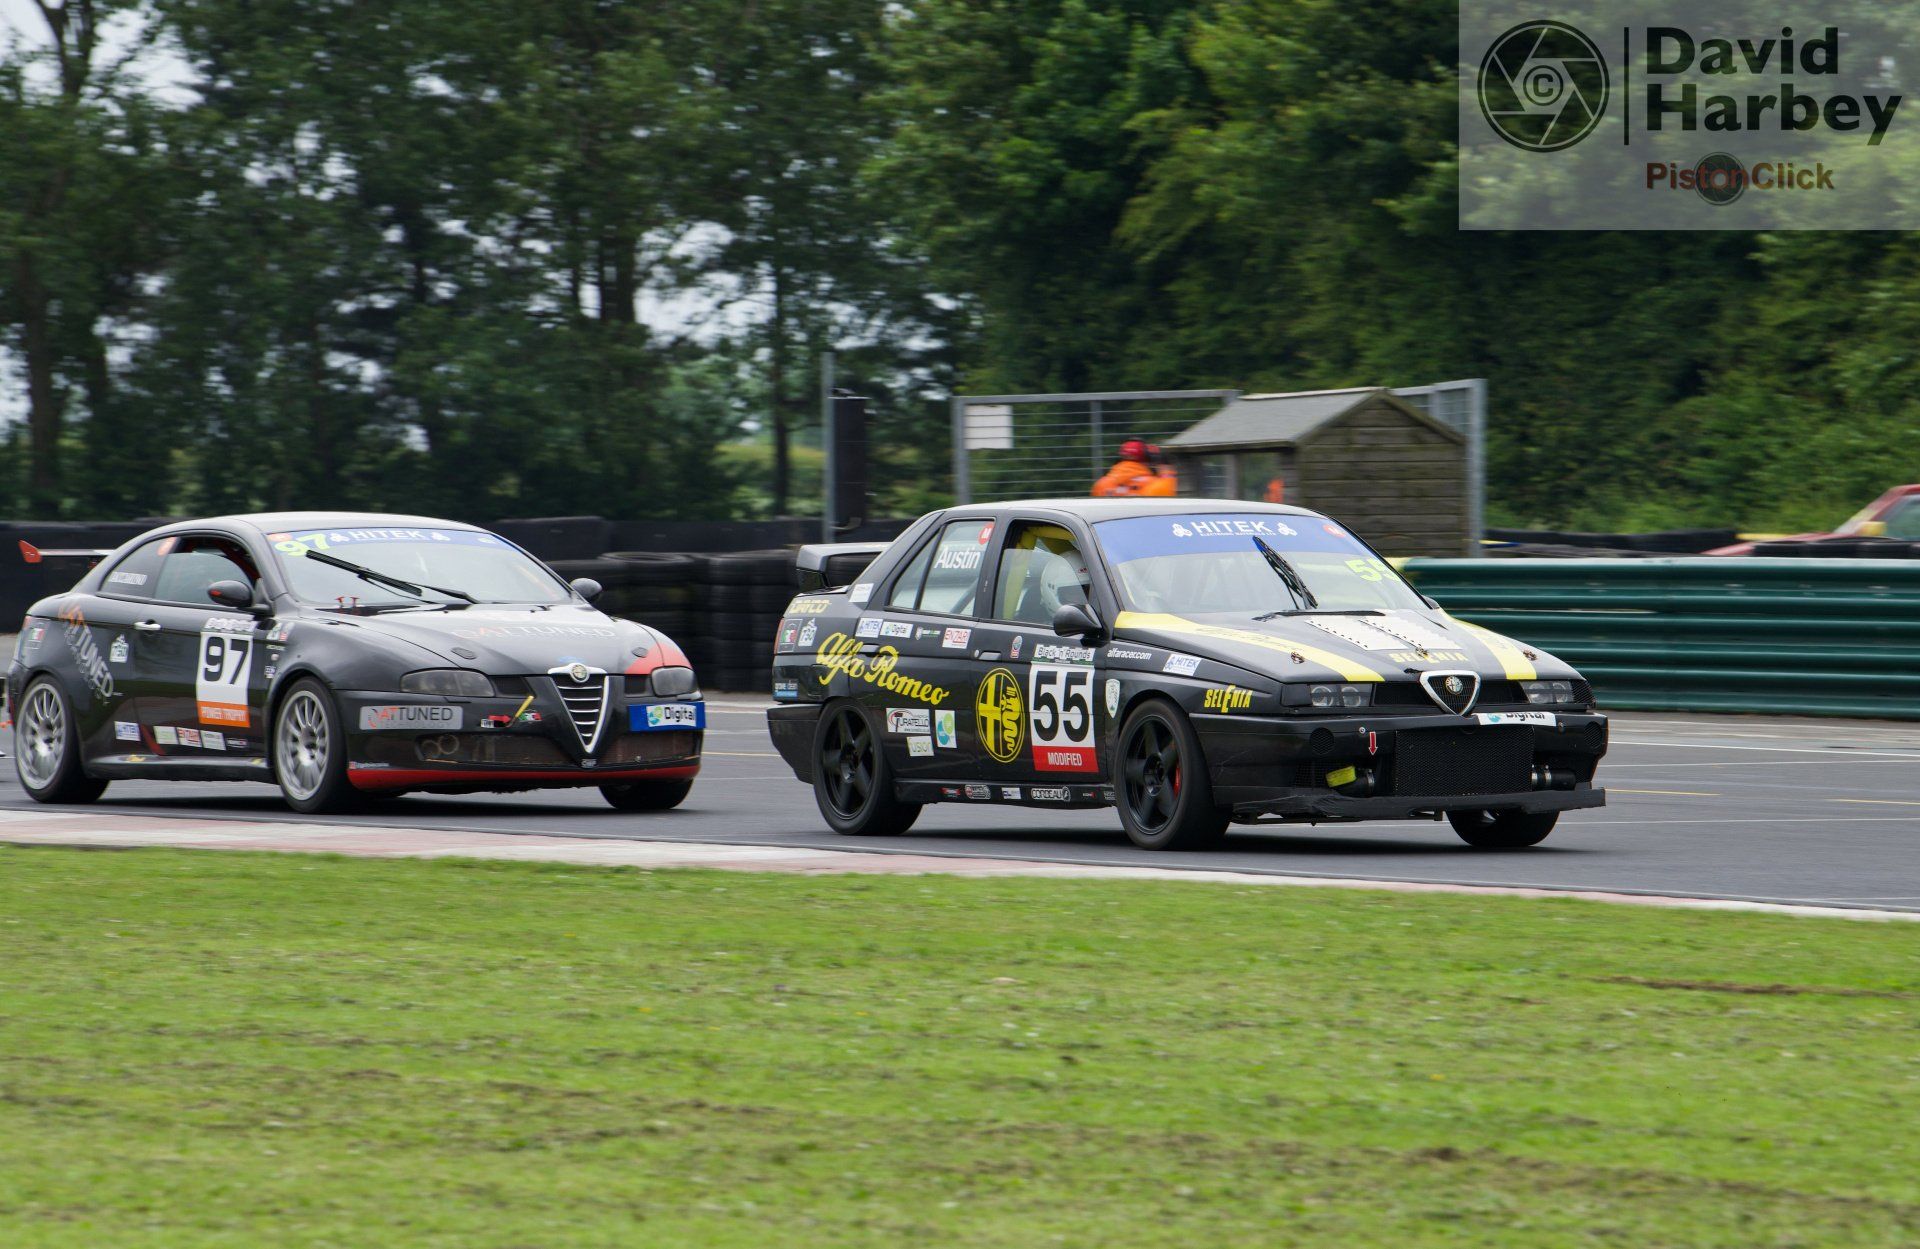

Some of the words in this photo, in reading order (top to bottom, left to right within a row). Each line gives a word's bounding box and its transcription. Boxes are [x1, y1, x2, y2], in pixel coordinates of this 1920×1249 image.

[349, 530, 422, 540] HITEK
[1191, 521, 1273, 533] HITEK
[274, 533, 331, 557] 97
[933, 546, 981, 570] Austin
[203, 636, 250, 685] 97
[1038, 647, 1056, 657] Black
[1065, 649, 1091, 659] Rounds
[1107, 648, 1152, 660] alfaracer.com
[816, 632, 865, 685] Alfa
[864, 645, 950, 705] Romeo
[1175, 657, 1197, 668] HITEK
[1033, 670, 1090, 742] 55
[1204, 685, 1253, 713] SELENIA
[664, 705, 696, 723] Digital
[1046, 752, 1083, 767] MODIFIED
